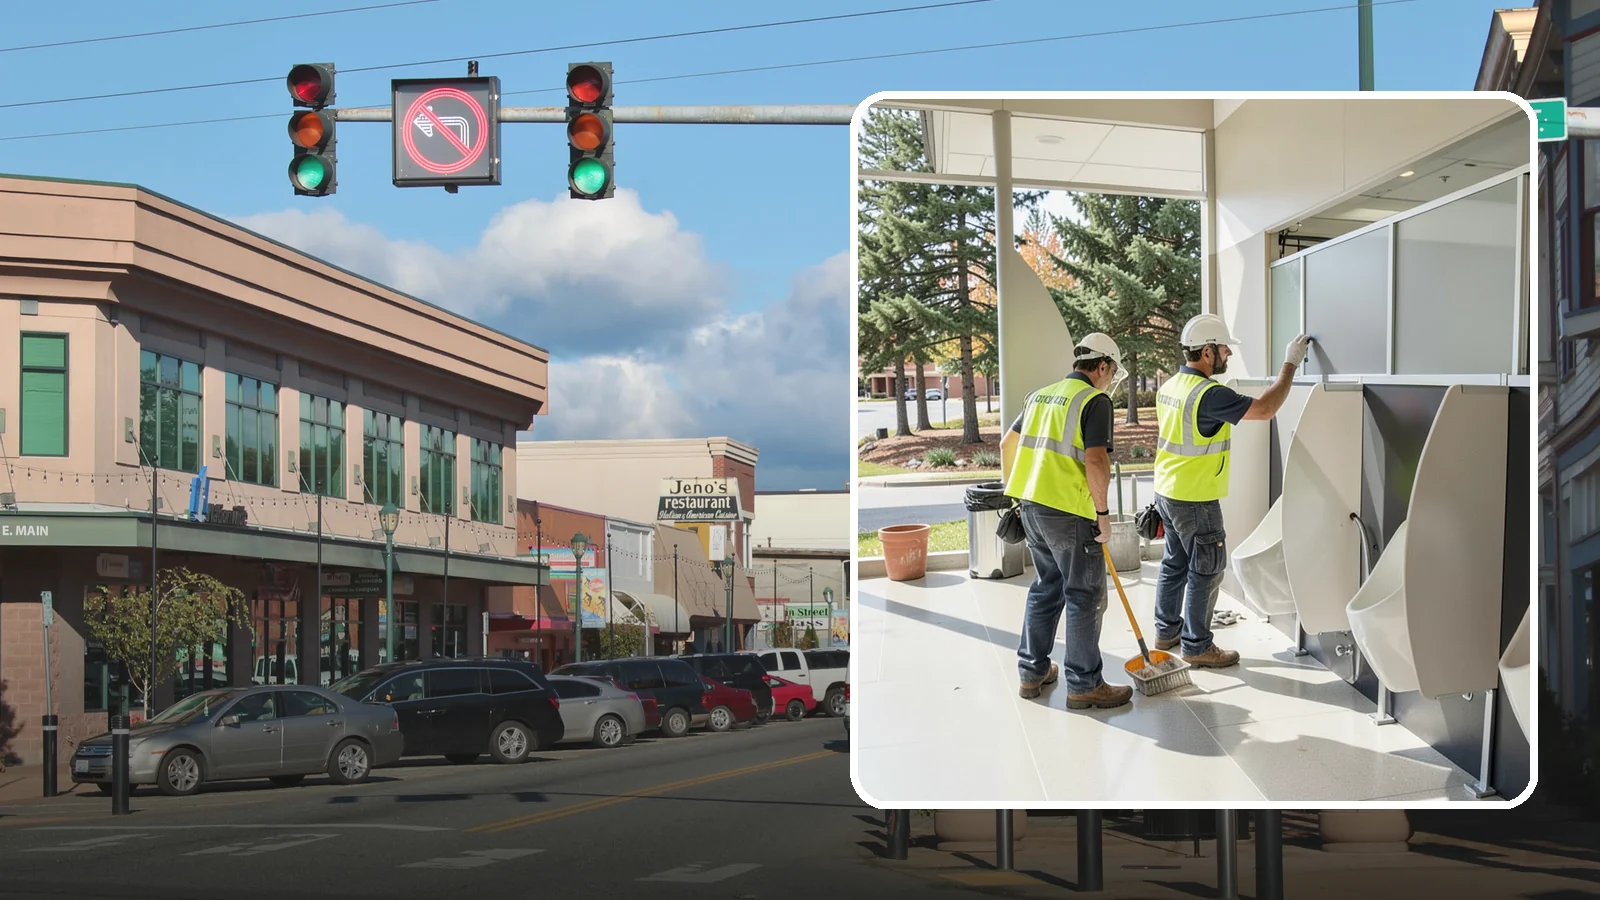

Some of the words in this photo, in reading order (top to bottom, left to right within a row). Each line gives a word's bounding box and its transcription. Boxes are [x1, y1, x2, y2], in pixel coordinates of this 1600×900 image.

[669, 480, 728, 495] Jeno's
[665, 496, 731, 509] restaurant
[658, 510, 682, 519] Italian
[686, 510, 714, 519] American
[715, 509, 738, 519] Cuisine
[2, 525, 13, 536] E.
[15, 525, 49, 536] MAIN
[797, 608, 829, 617] Street
